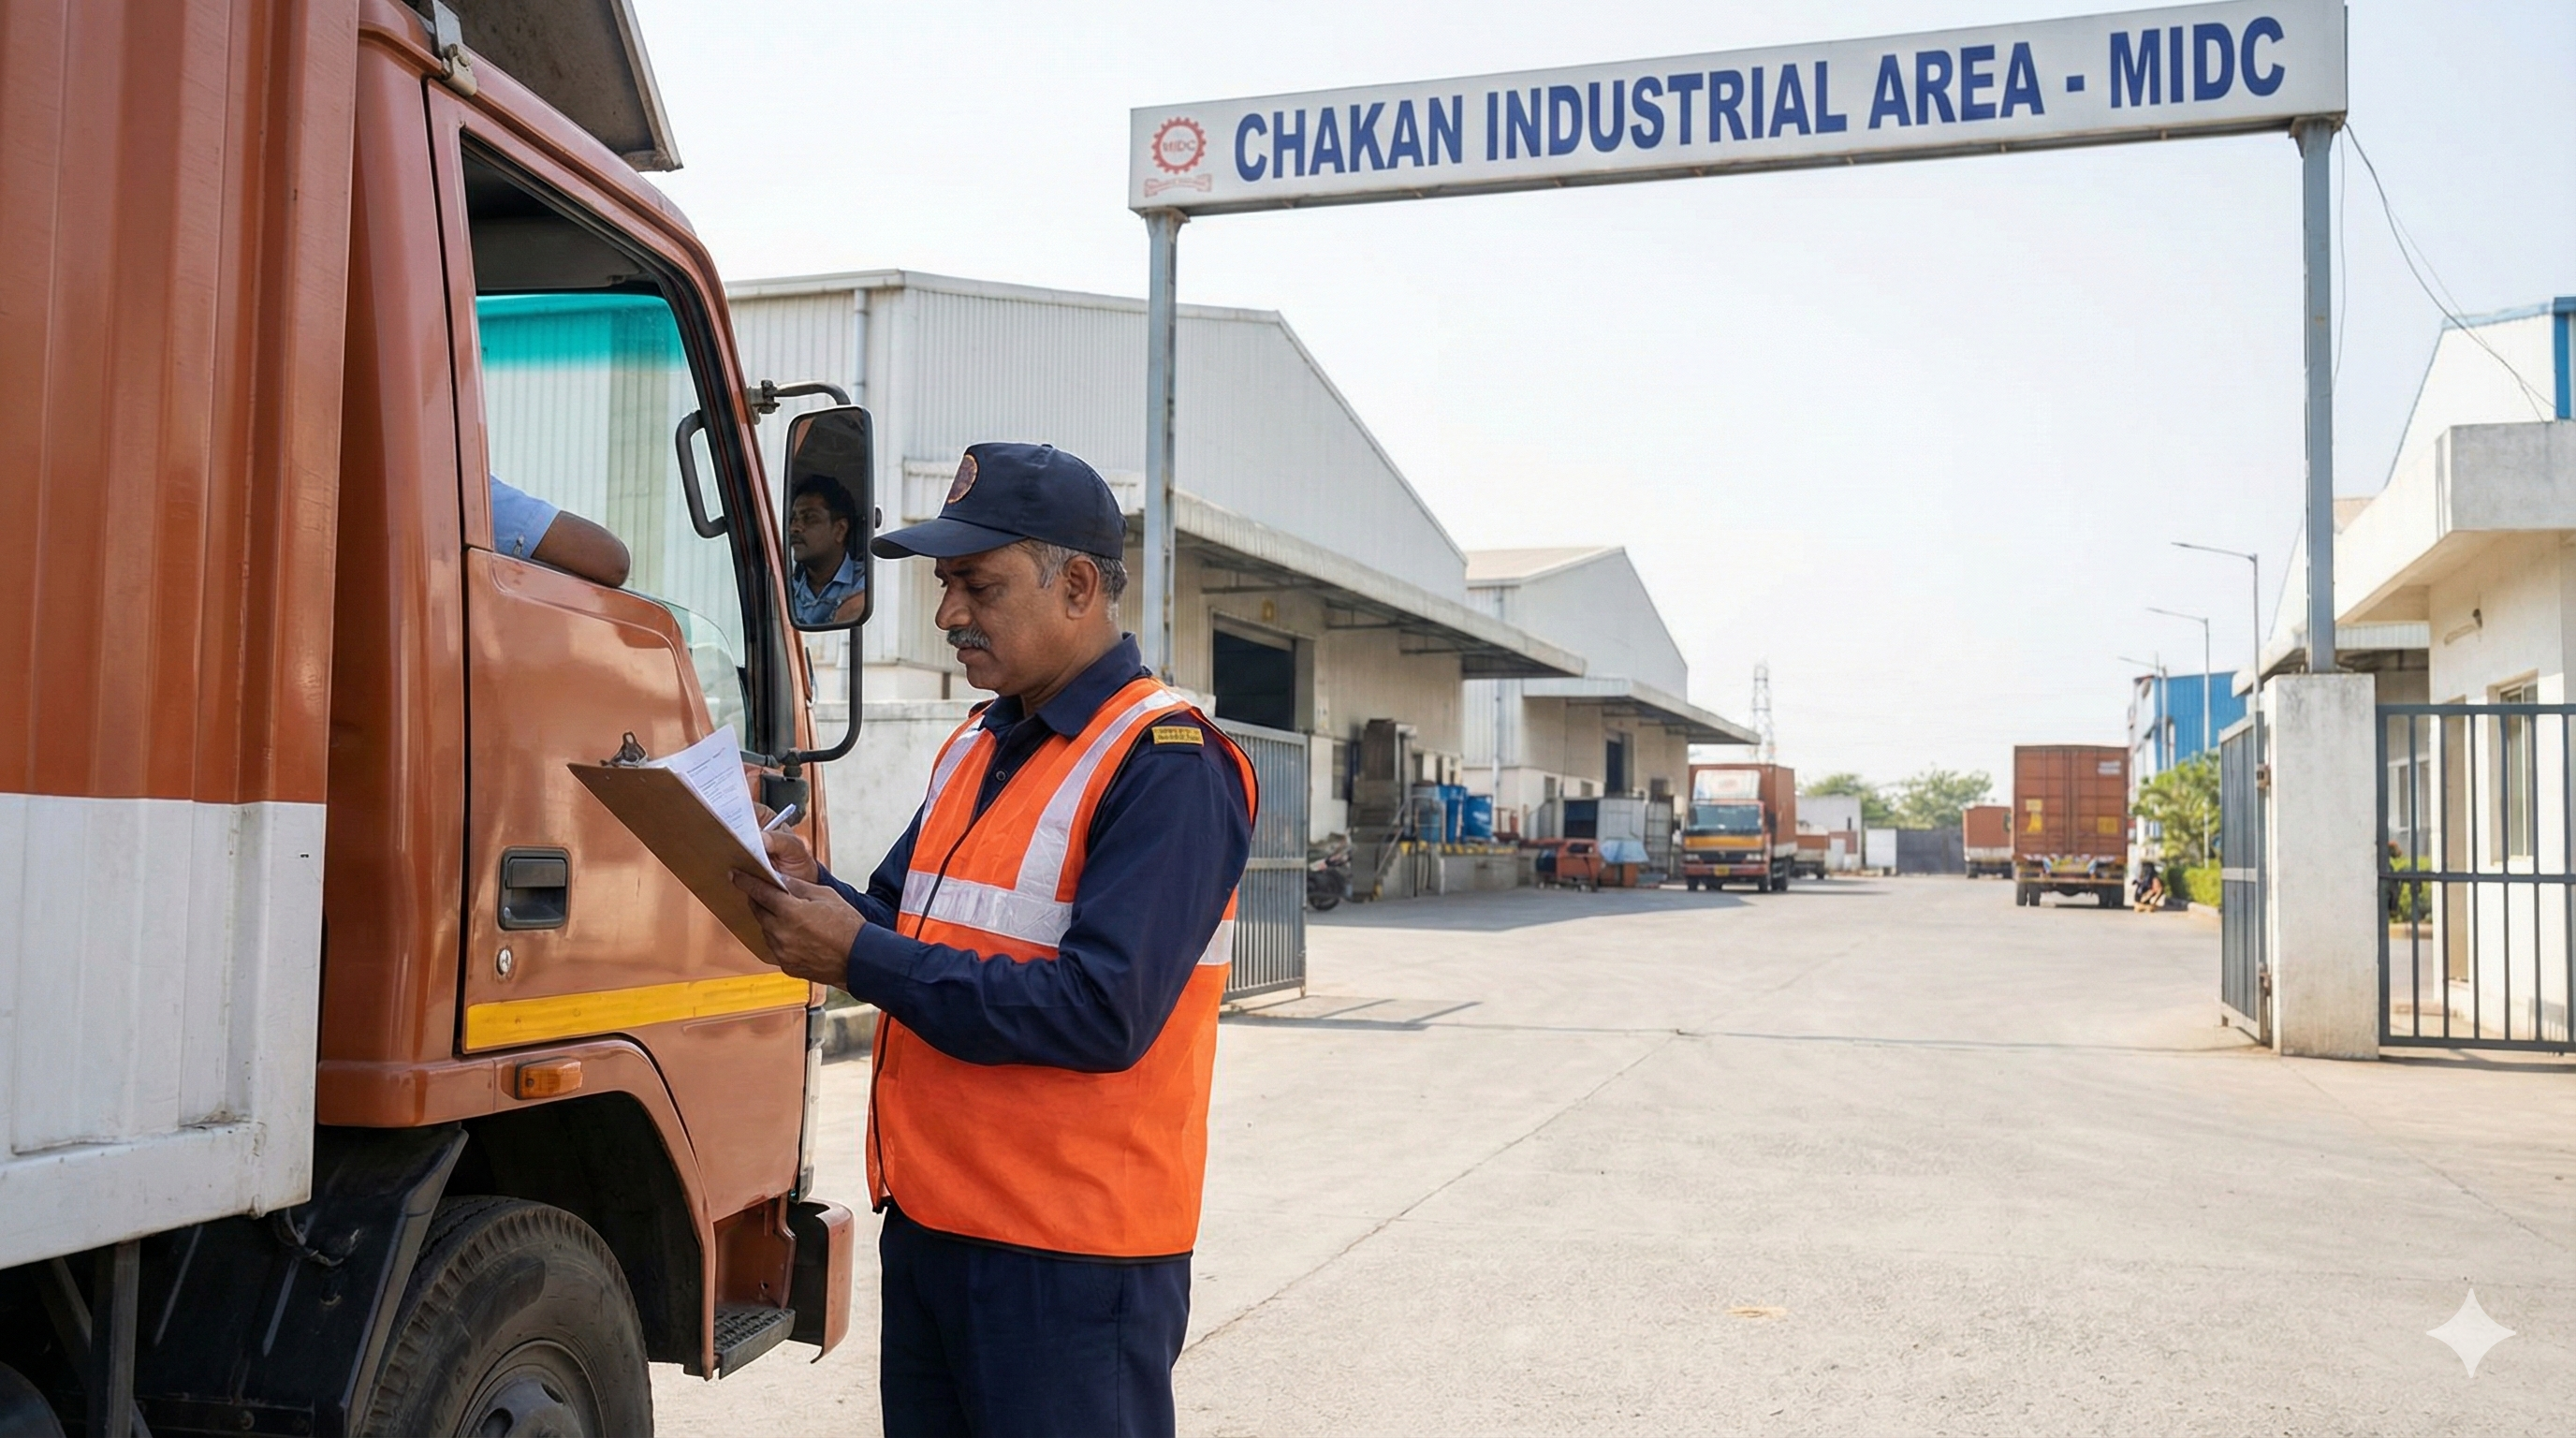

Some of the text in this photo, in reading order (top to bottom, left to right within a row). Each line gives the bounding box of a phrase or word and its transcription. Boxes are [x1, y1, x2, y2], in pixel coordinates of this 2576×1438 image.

[1234, 16, 2287, 183] CHAKAN INDUSTRIAL AREA - MIDC
